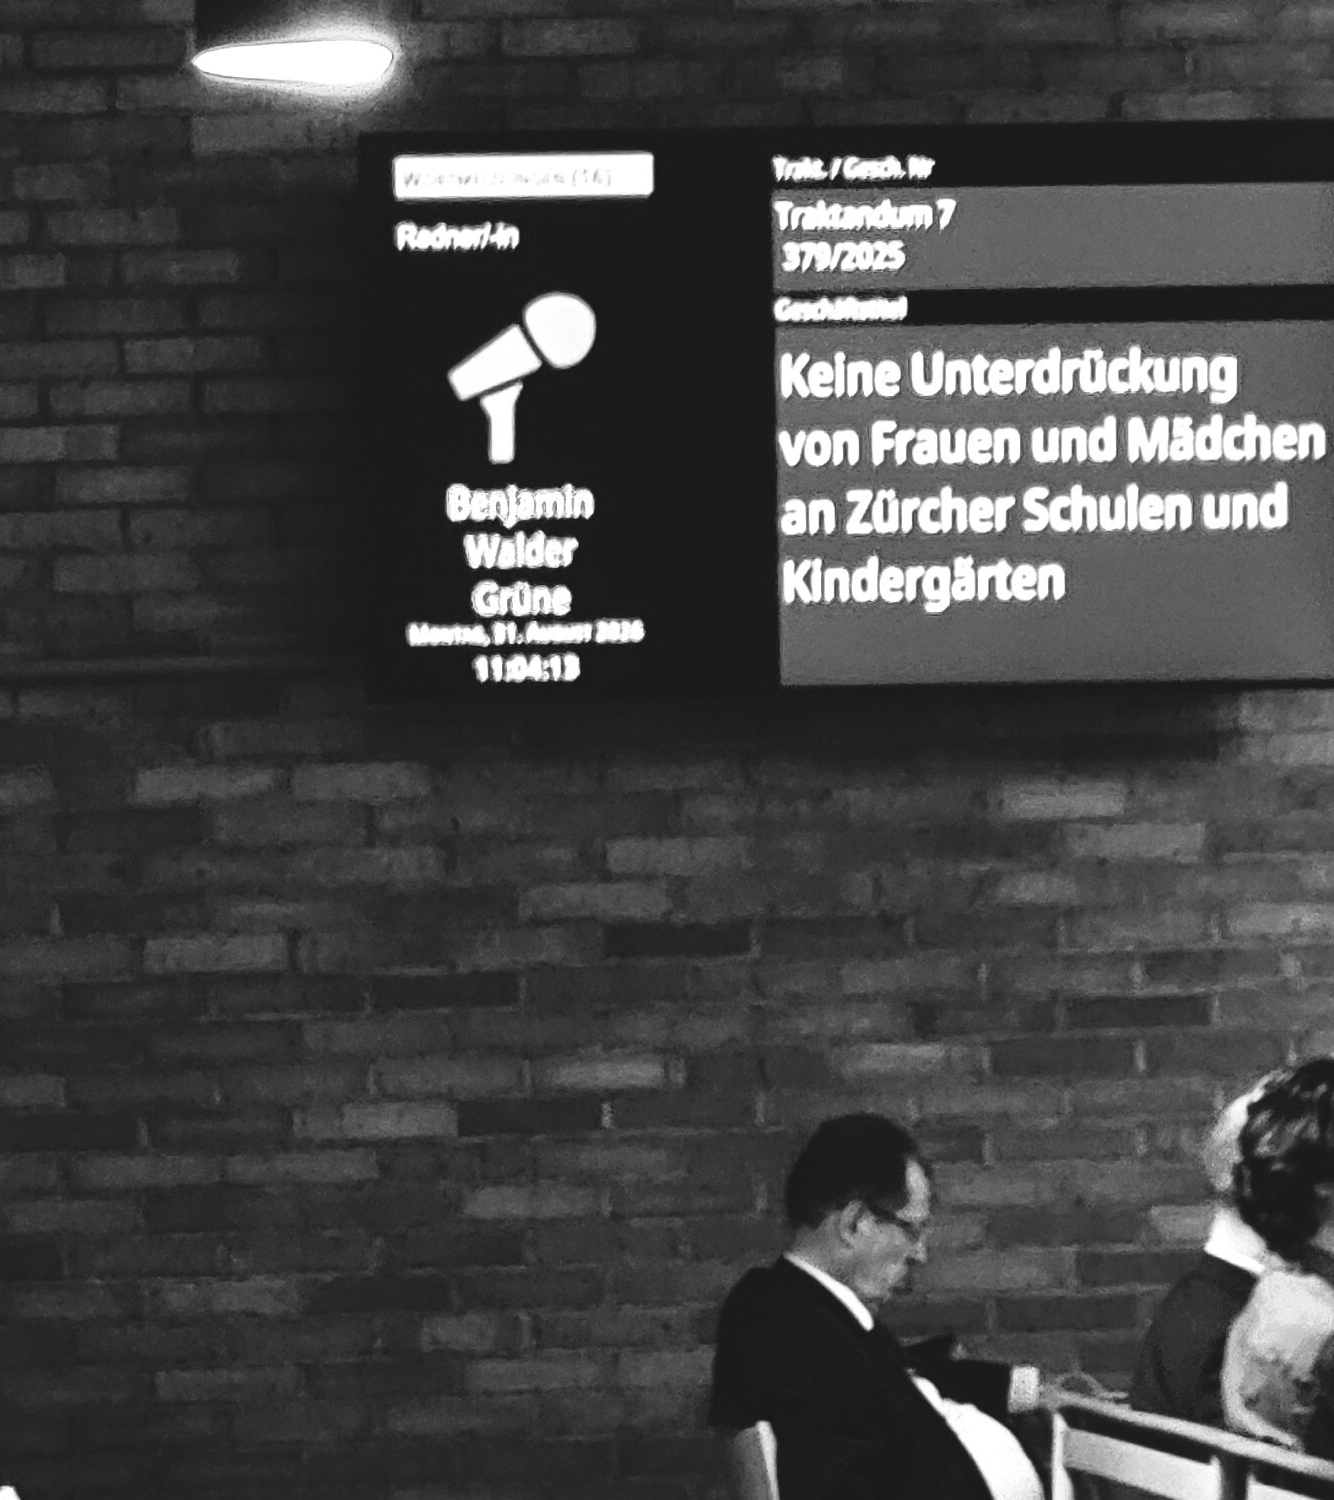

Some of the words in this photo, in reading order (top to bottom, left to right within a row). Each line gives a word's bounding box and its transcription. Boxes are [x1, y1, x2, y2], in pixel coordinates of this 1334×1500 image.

[774, 199, 933, 230] Traktandum
[936, 199, 956, 229] 7
[782, 240, 905, 272] 379/2025
[781, 352, 901, 398] Keine
[911, 345, 1237, 404] Unterdrückung
[778, 430, 859, 467] von
[872, 420, 1020, 466] Frauen
[1031, 415, 1116, 463] und
[1128, 412, 1325, 463] Mädchen
[446, 483, 594, 529] Benjamin
[781, 499, 835, 535] an
[846, 486, 1015, 534] Zürcher
[1022, 483, 1192, 532] Schulen
[1203, 481, 1288, 529] und
[463, 531, 578, 569] Walder
[471, 580, 572, 618] Grüne
[783, 555, 1065, 613] Kindergärten
